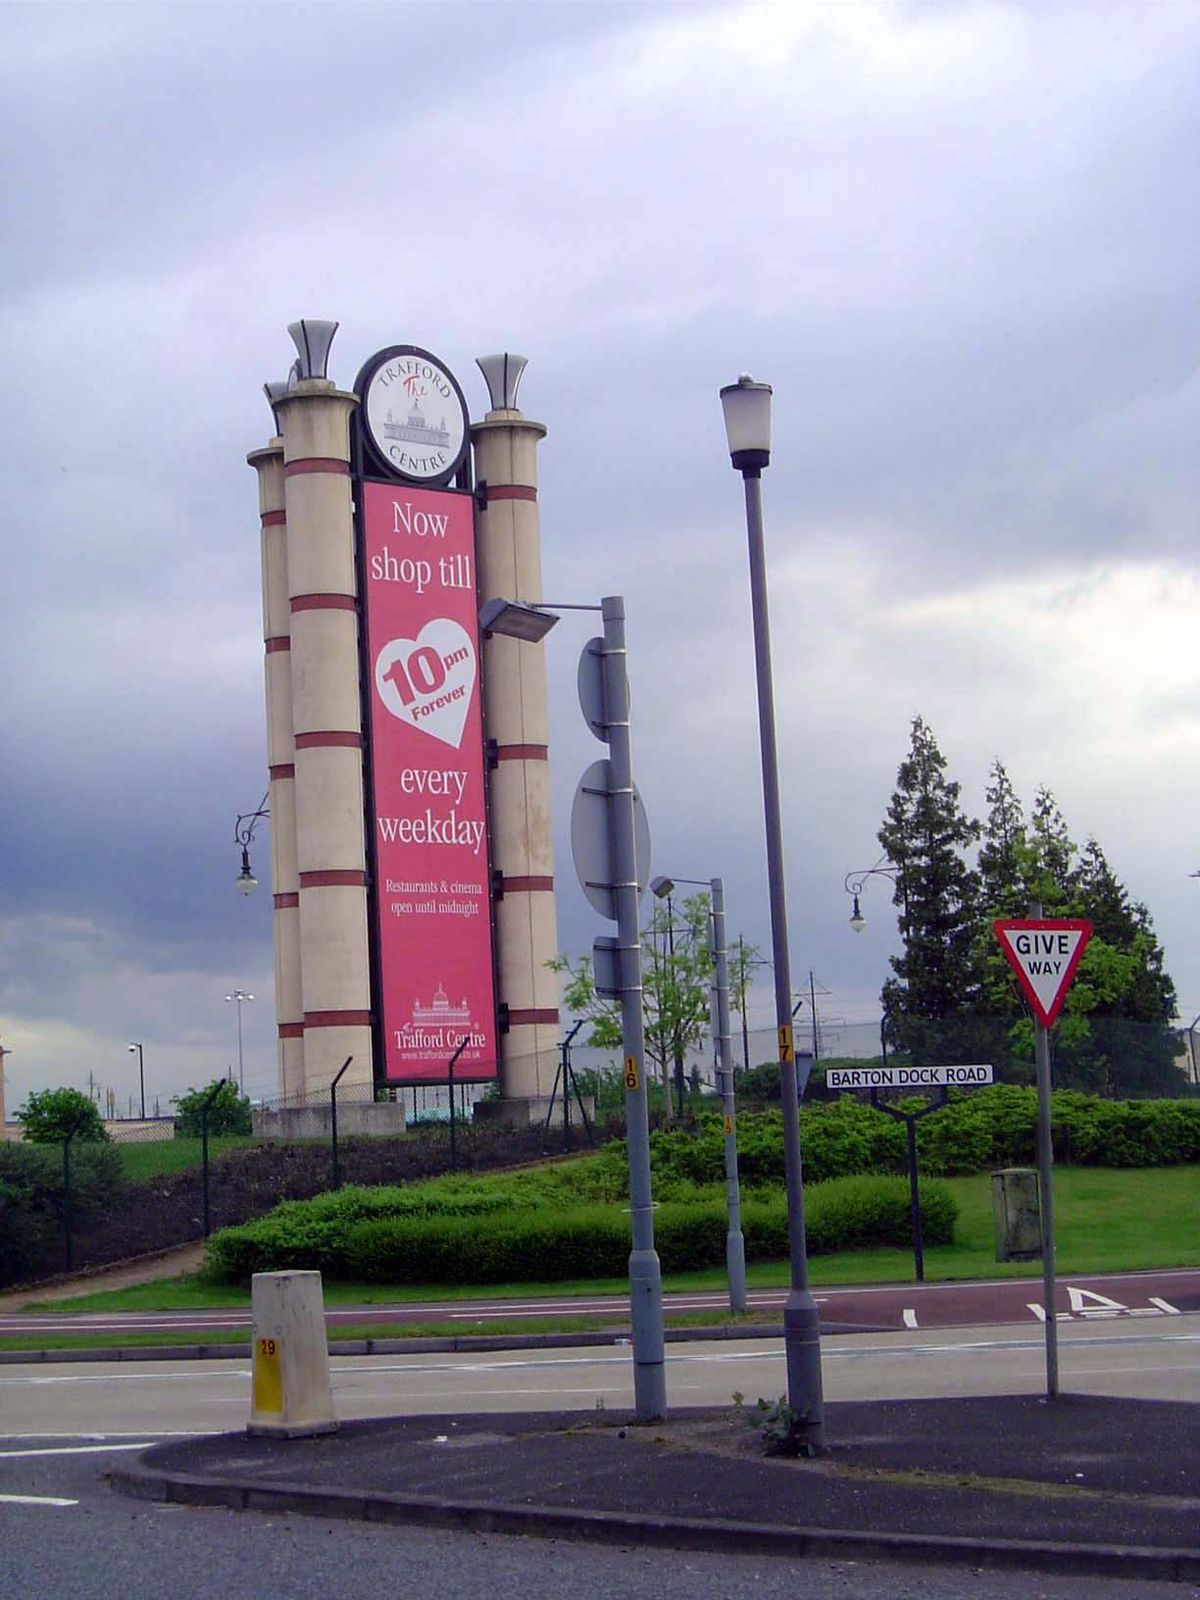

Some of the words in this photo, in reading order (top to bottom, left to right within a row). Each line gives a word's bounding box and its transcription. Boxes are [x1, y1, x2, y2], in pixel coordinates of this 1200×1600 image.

[378, 361, 451, 398] TRAFFORD
[403, 375, 427, 398] The
[389, 445, 447, 472] CENTRE
[392, 501, 448, 538] Now
[371, 546, 432, 594] shop
[439, 554, 472, 589] till
[411, 684, 466, 721] Forever
[400, 767, 468, 804] every
[377, 809, 485, 854] weekday
[386, 879, 438, 893] Restaurants
[440, 881, 448, 893] &
[450, 881, 482, 894] cinema
[391, 902, 413, 917] open
[415, 900, 436, 914] until
[438, 900, 479, 917] midnight
[1015, 935, 1069, 955] GIVE
[1028, 961, 1061, 975] WAY
[394, 1028, 444, 1049] Trafford
[831, 1068, 894, 1086] BARTON
[899, 1068, 940, 1084] DOCK
[946, 1067, 987, 1082] ROAD
[261, 1340, 275, 1355] 29
